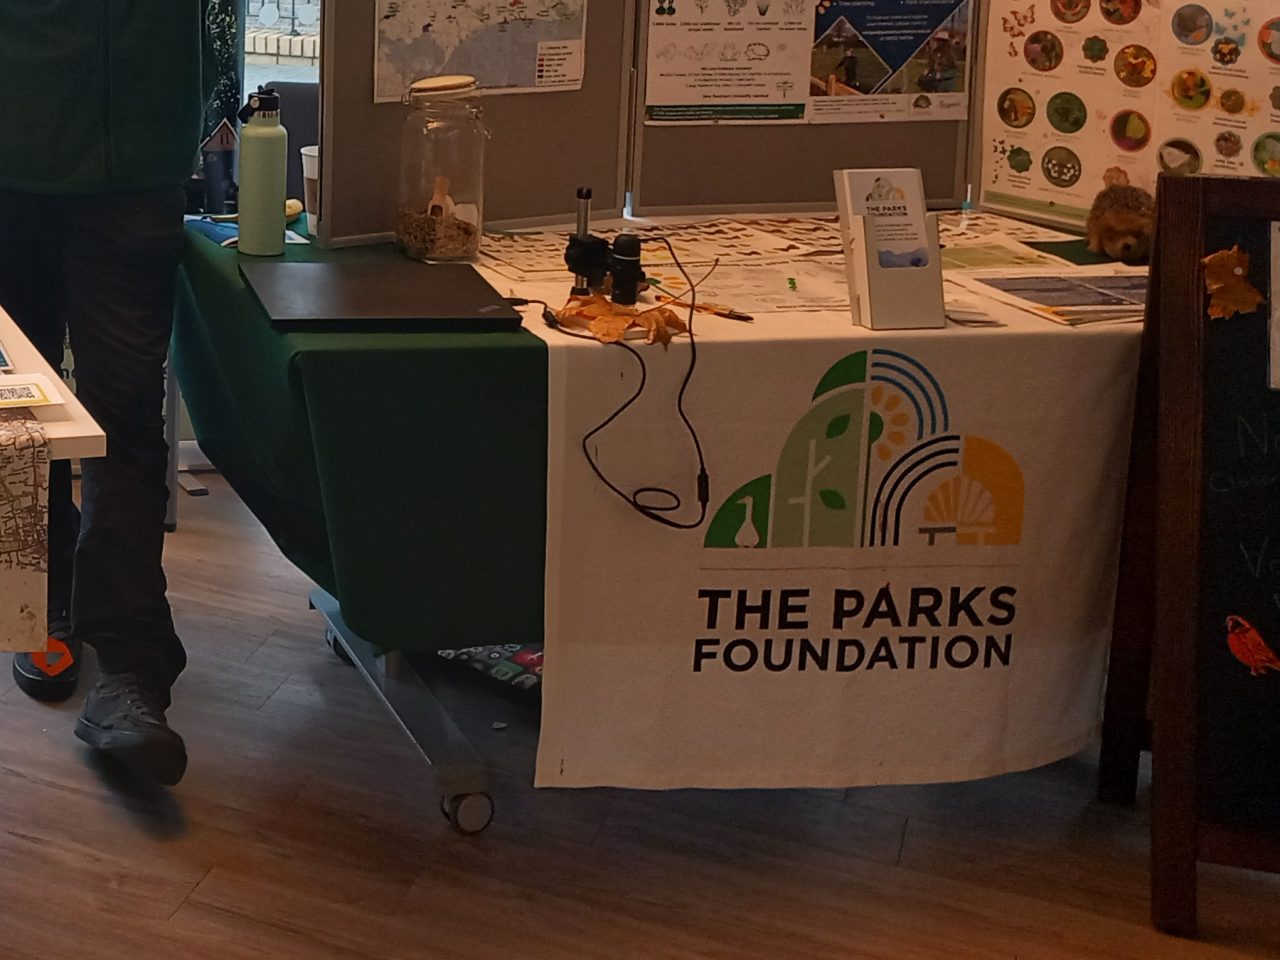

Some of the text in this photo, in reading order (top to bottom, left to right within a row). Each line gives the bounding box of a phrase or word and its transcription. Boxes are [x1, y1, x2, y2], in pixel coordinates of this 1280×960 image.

[698, 585, 1017, 630] THE PARKS
[693, 634, 1013, 672] FOUNDATION
